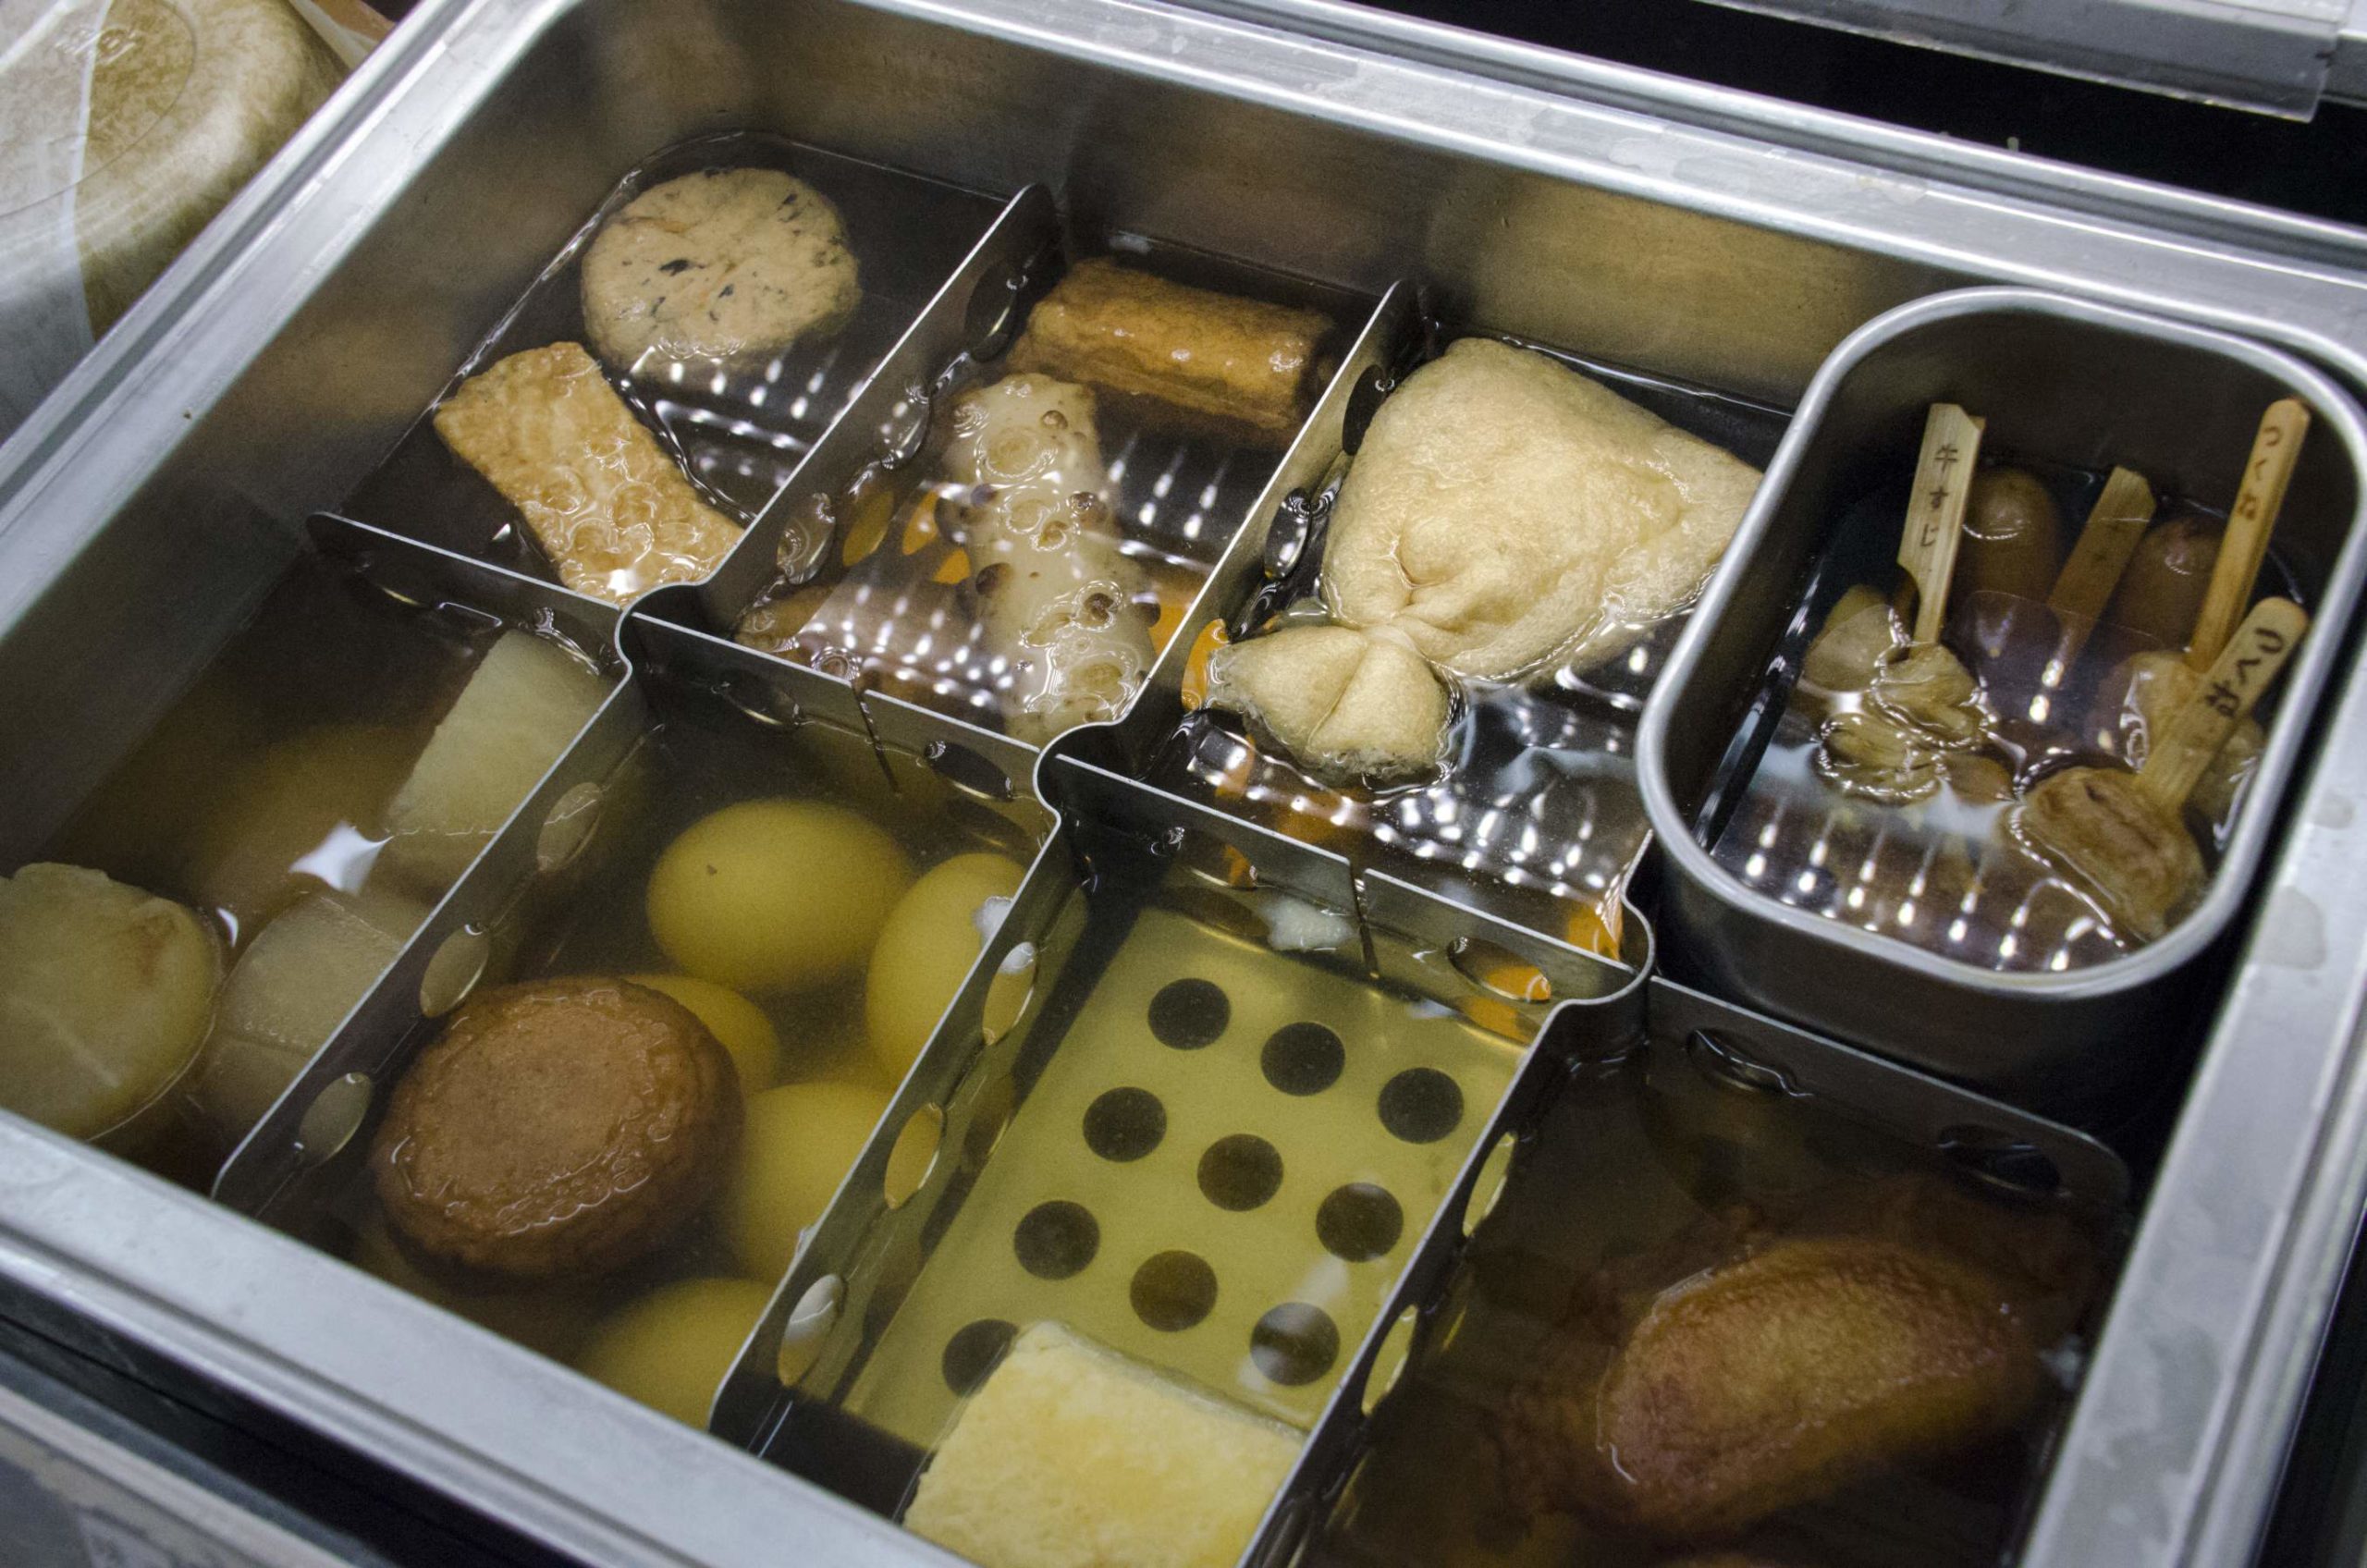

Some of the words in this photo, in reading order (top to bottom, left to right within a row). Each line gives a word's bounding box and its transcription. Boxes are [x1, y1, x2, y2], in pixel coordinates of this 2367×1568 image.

[1919, 443, 1958, 547] 牛すじ
[2237, 425, 2281, 521] つくね
[2204, 627, 2285, 718] つくね
